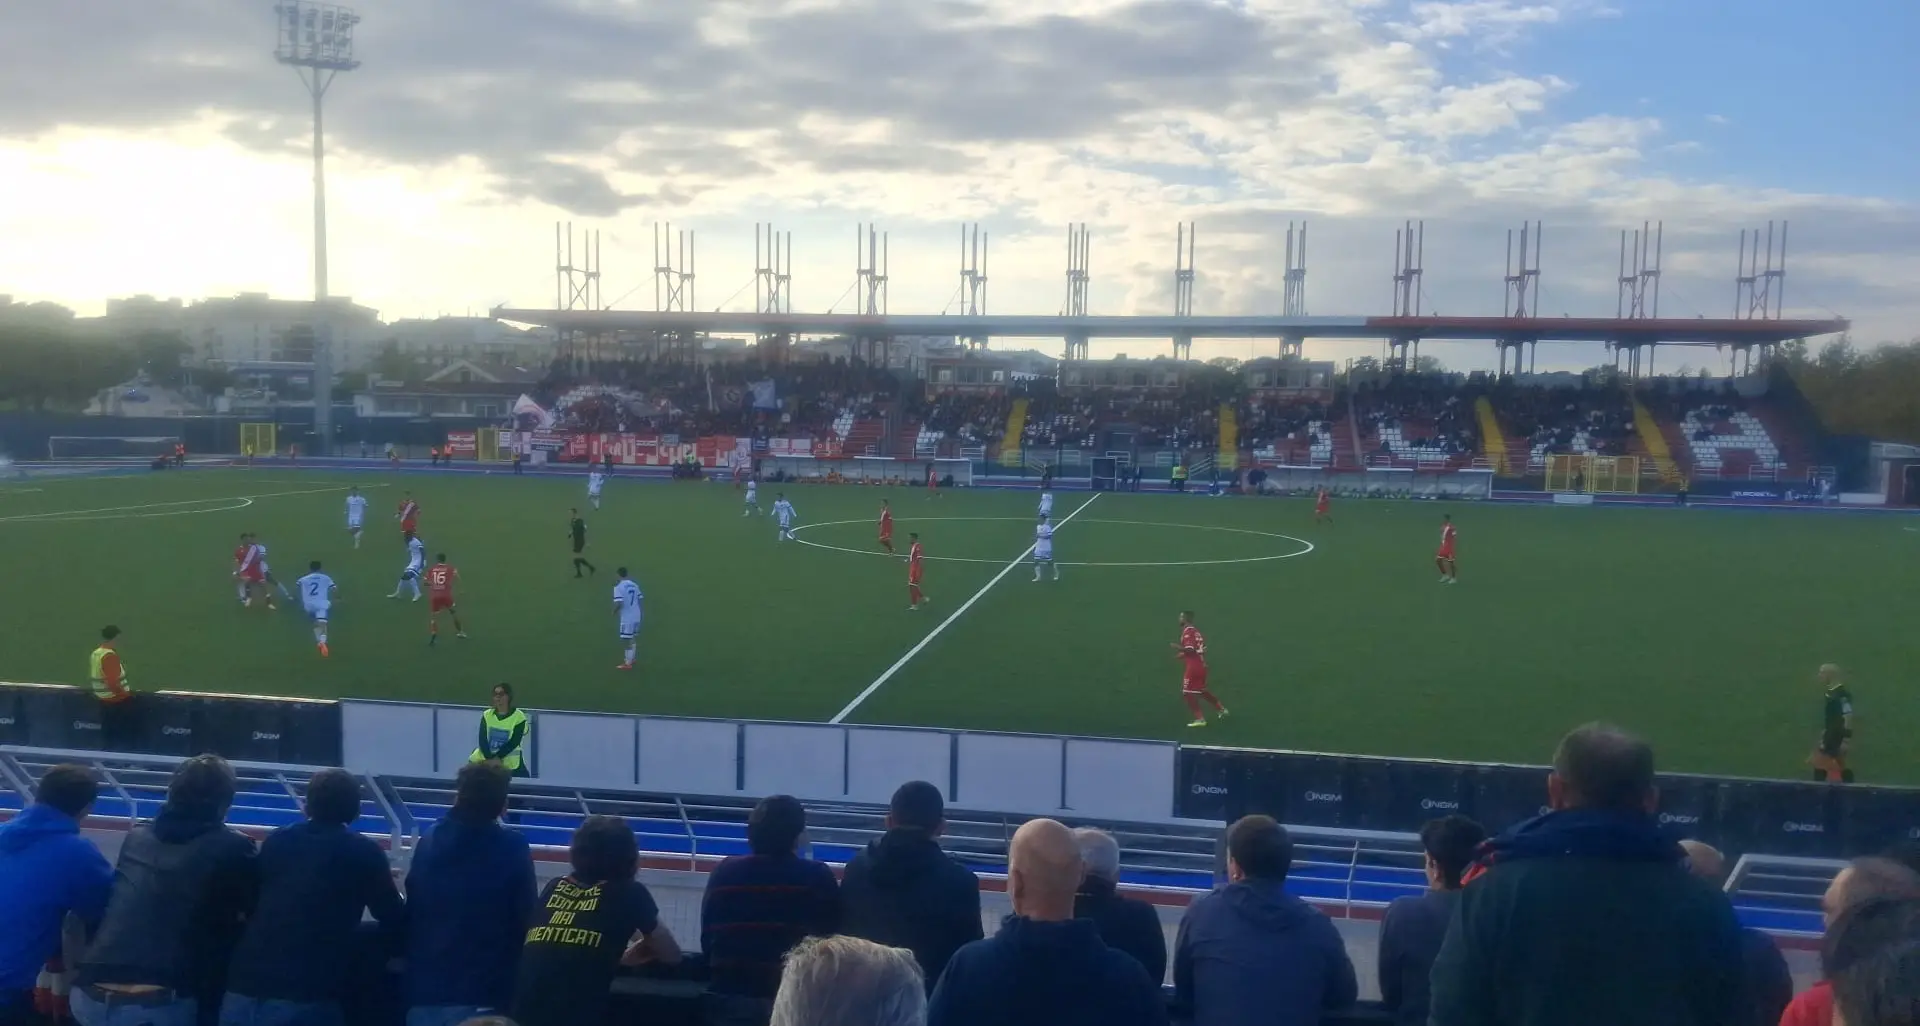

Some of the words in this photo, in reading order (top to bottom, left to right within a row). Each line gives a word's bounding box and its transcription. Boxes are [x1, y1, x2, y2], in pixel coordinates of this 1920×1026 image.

[433, 571, 446, 585] 16
[308, 582, 320, 597] 2
[628, 589, 636, 607] 7
[546, 894, 574, 911] CON
[574, 898, 598, 911] NOI
[549, 911, 577, 926] MAI
